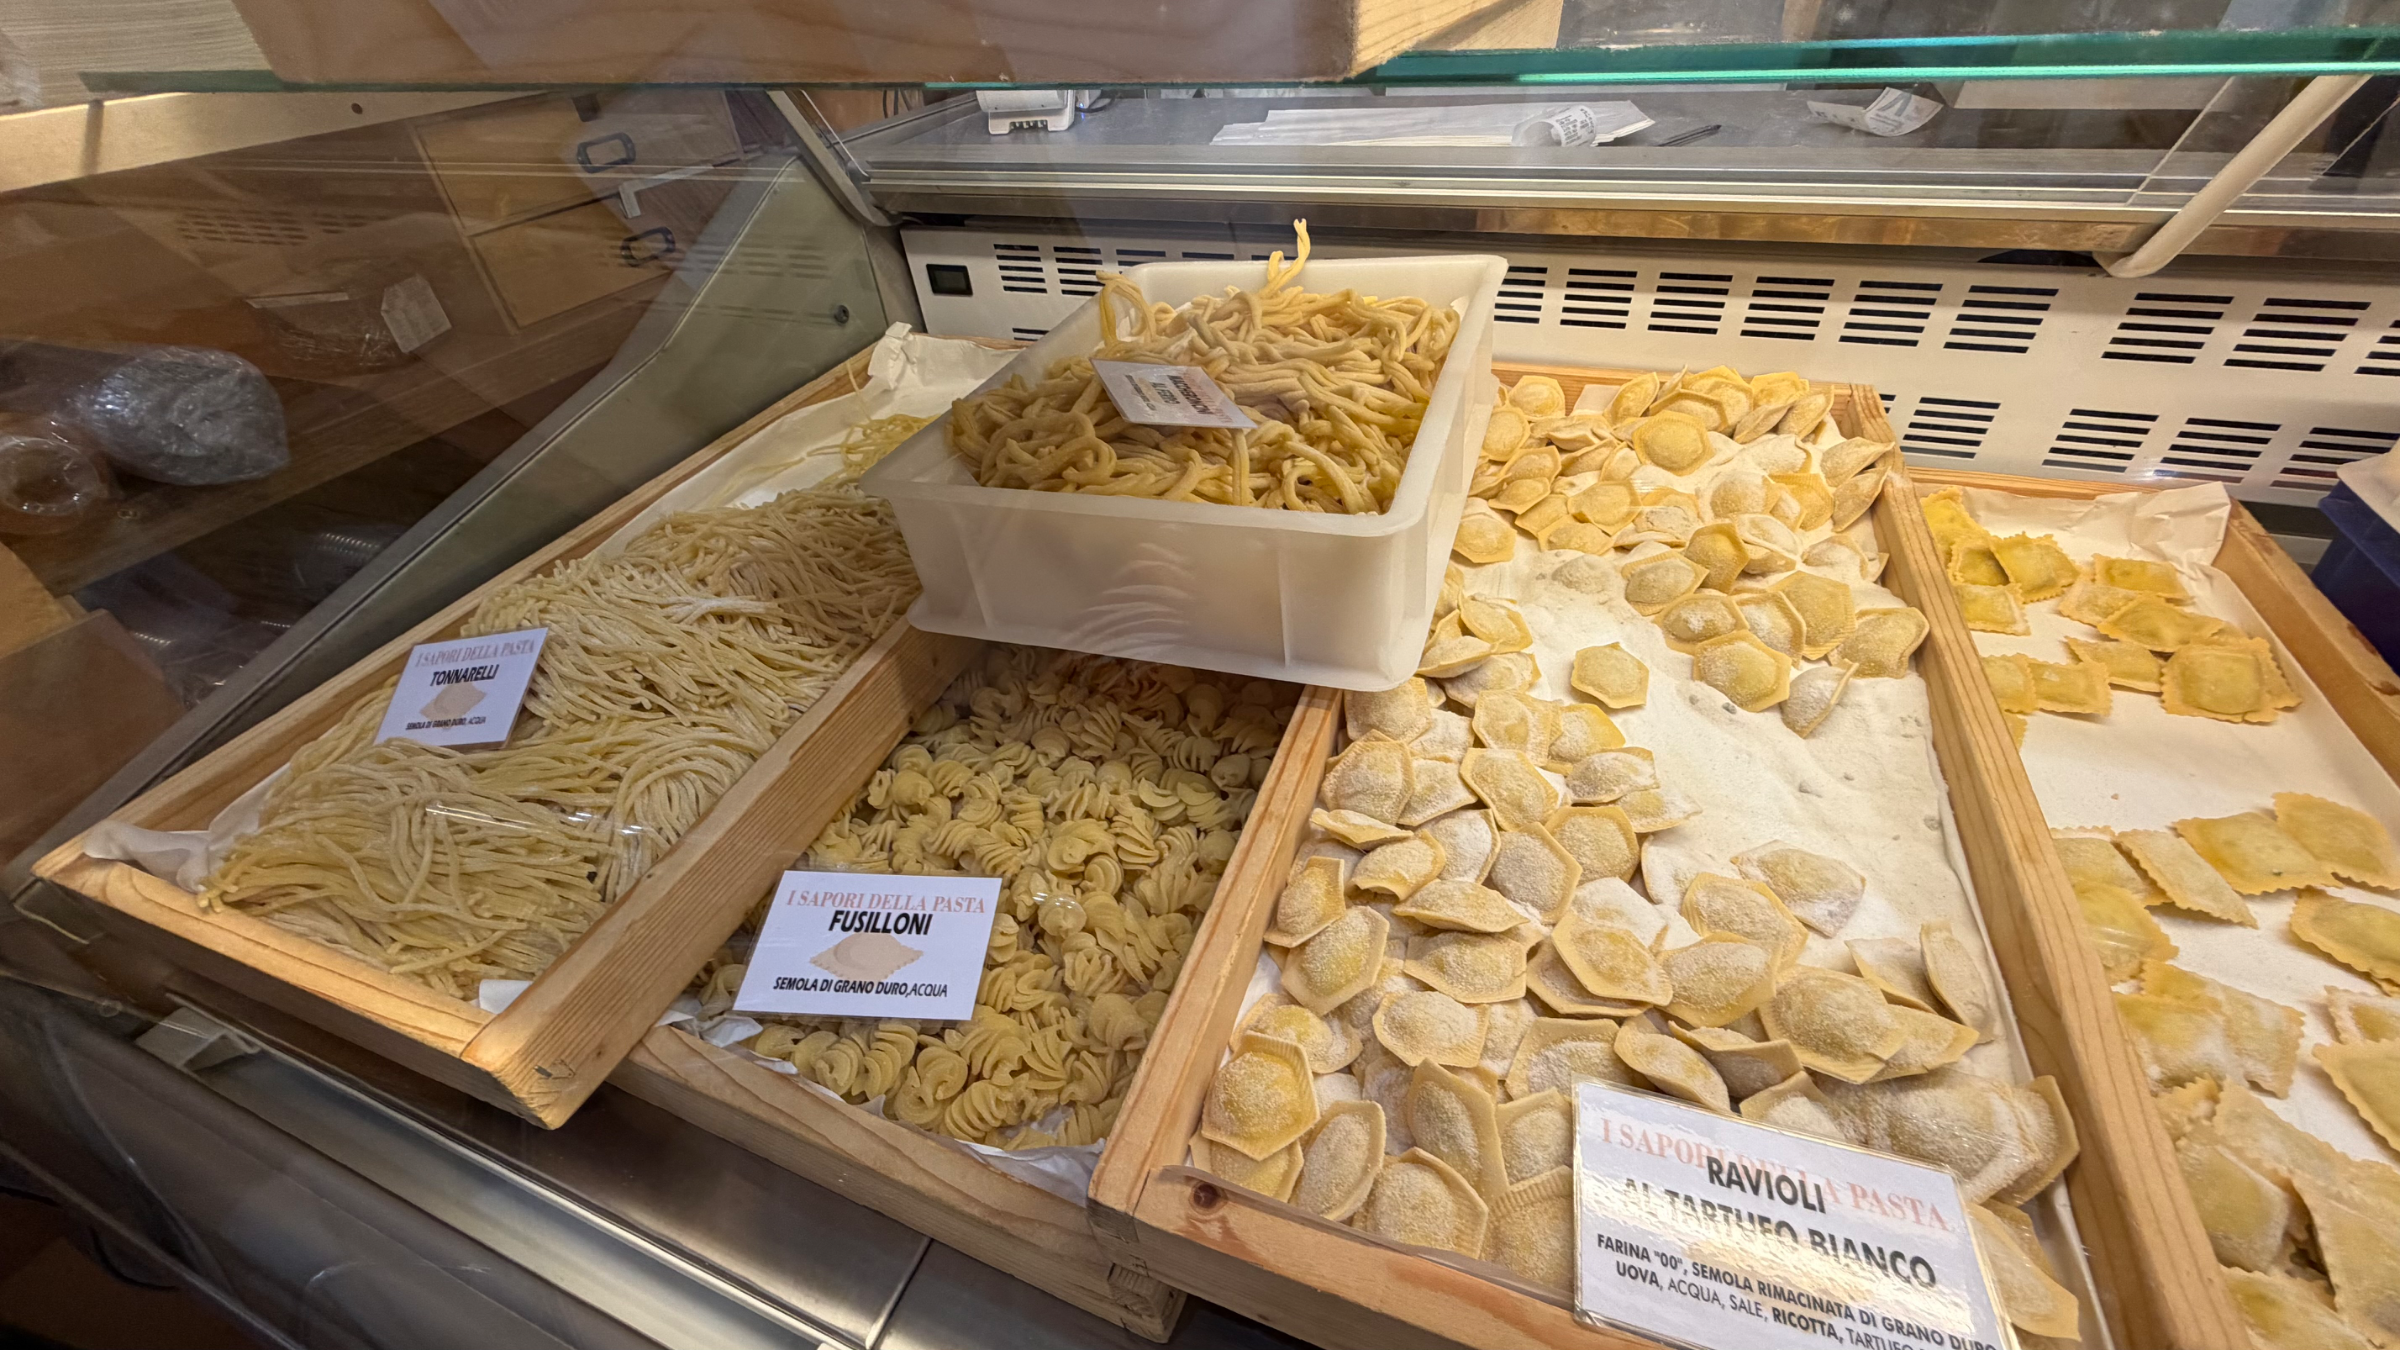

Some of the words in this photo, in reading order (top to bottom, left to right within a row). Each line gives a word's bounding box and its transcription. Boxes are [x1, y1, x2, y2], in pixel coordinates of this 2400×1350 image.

[415, 653, 423, 667] I
[422, 647, 462, 667] SAPORI
[462, 645, 498, 662] DELLA
[500, 640, 535, 657] PASTA
[430, 664, 499, 687] TONNARELLI
[786, 889, 797, 906] I
[797, 891, 864, 909] SAPORI
[865, 893, 927, 911] DELLA
[932, 896, 985, 914] PASTA
[828, 910, 933, 935] FUSILLONI
[773, 977, 818, 991] SEMOLA
[819, 979, 834, 992] DI
[834, 980, 875, 994] GRANO
[1601, 1118, 1612, 1144] I
[1620, 1124, 1727, 1174] SAPORI
[1847, 1182, 1949, 1232] PASTA
[1706, 1155, 1826, 1214] RAVIOLI
[1808, 1228, 1936, 1288] BIANCO
[1597, 1233, 1650, 1263] FARINA
[1692, 1262, 1754, 1293] SEMOLA
[1757, 1280, 1855, 1322] RIMACINATA
[1858, 1309, 1877, 1328] DI
[1881, 1316, 1944, 1346] GRANO
[1616, 1261, 1664, 1291] UOVA,
[1668, 1279, 1725, 1310] ACQUA,
[1729, 1295, 1768, 1323] SALE,
[1772, 1305, 1844, 1344] RICOTTA,
